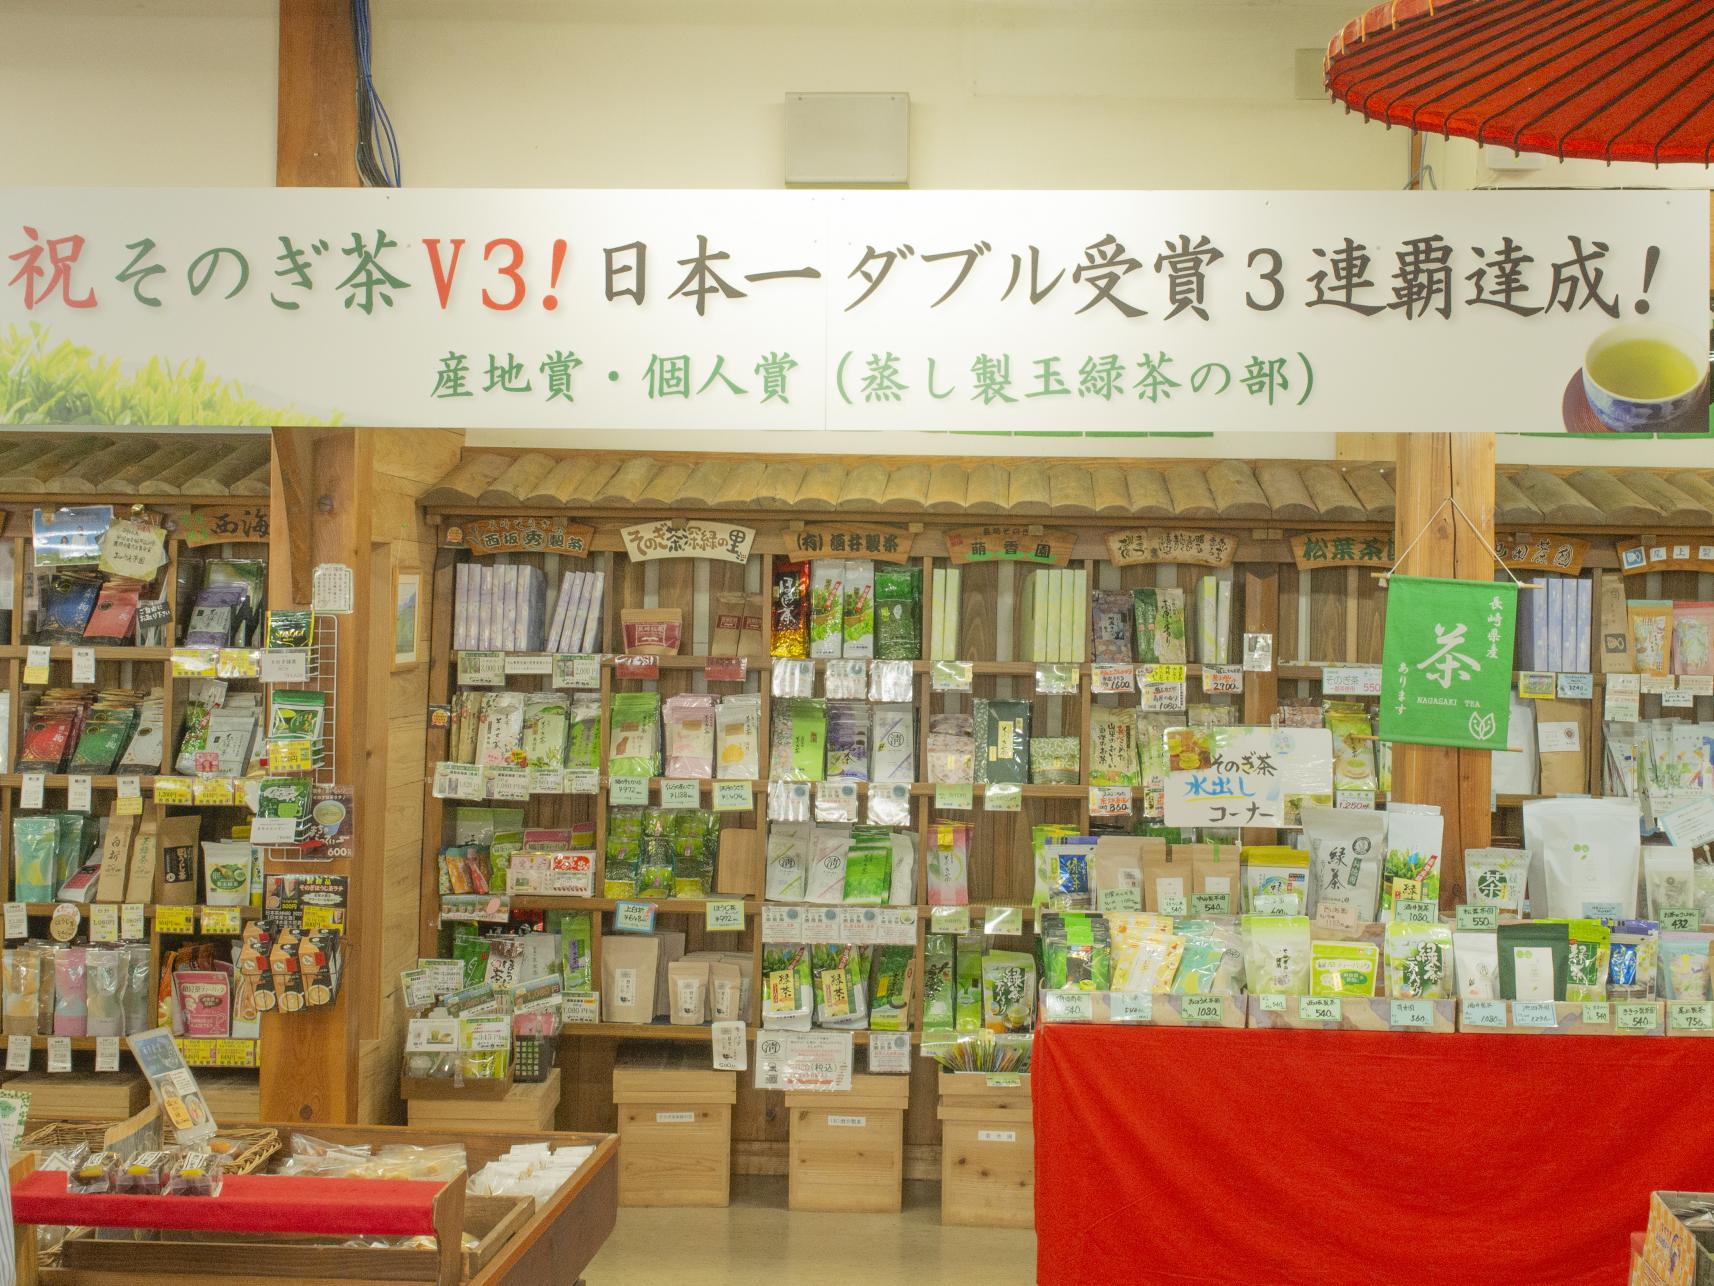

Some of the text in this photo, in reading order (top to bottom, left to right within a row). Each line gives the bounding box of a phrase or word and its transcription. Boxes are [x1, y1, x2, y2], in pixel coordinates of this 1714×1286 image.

[1302, 537, 1396, 561] 松葉茶
[1487, 596, 1504, 660] 長崎県産
[1417, 623, 1481, 689] 茶
[1394, 661, 1408, 715] あります
[1417, 696, 1481, 708] NAGASAKI TEA
[1210, 751, 1278, 778] そのぎ茶
[1183, 773, 1257, 797] 水出し
[1209, 801, 1275, 824] コーナー
[327, 847, 348, 857] 600
[1324, 846, 1348, 890] 緑茶
[1479, 870, 1508, 899] 茶
[1472, 917, 1490, 926] 550
[1671, 919, 1689, 930] 432
[778, 972, 792, 998] 緑茶
[830, 973, 846, 1000] 緑茶
[1197, 1007, 1217, 1016] 1080
[1315, 1009, 1333, 1018] 540
[1632, 1017, 1649, 1026] 540
